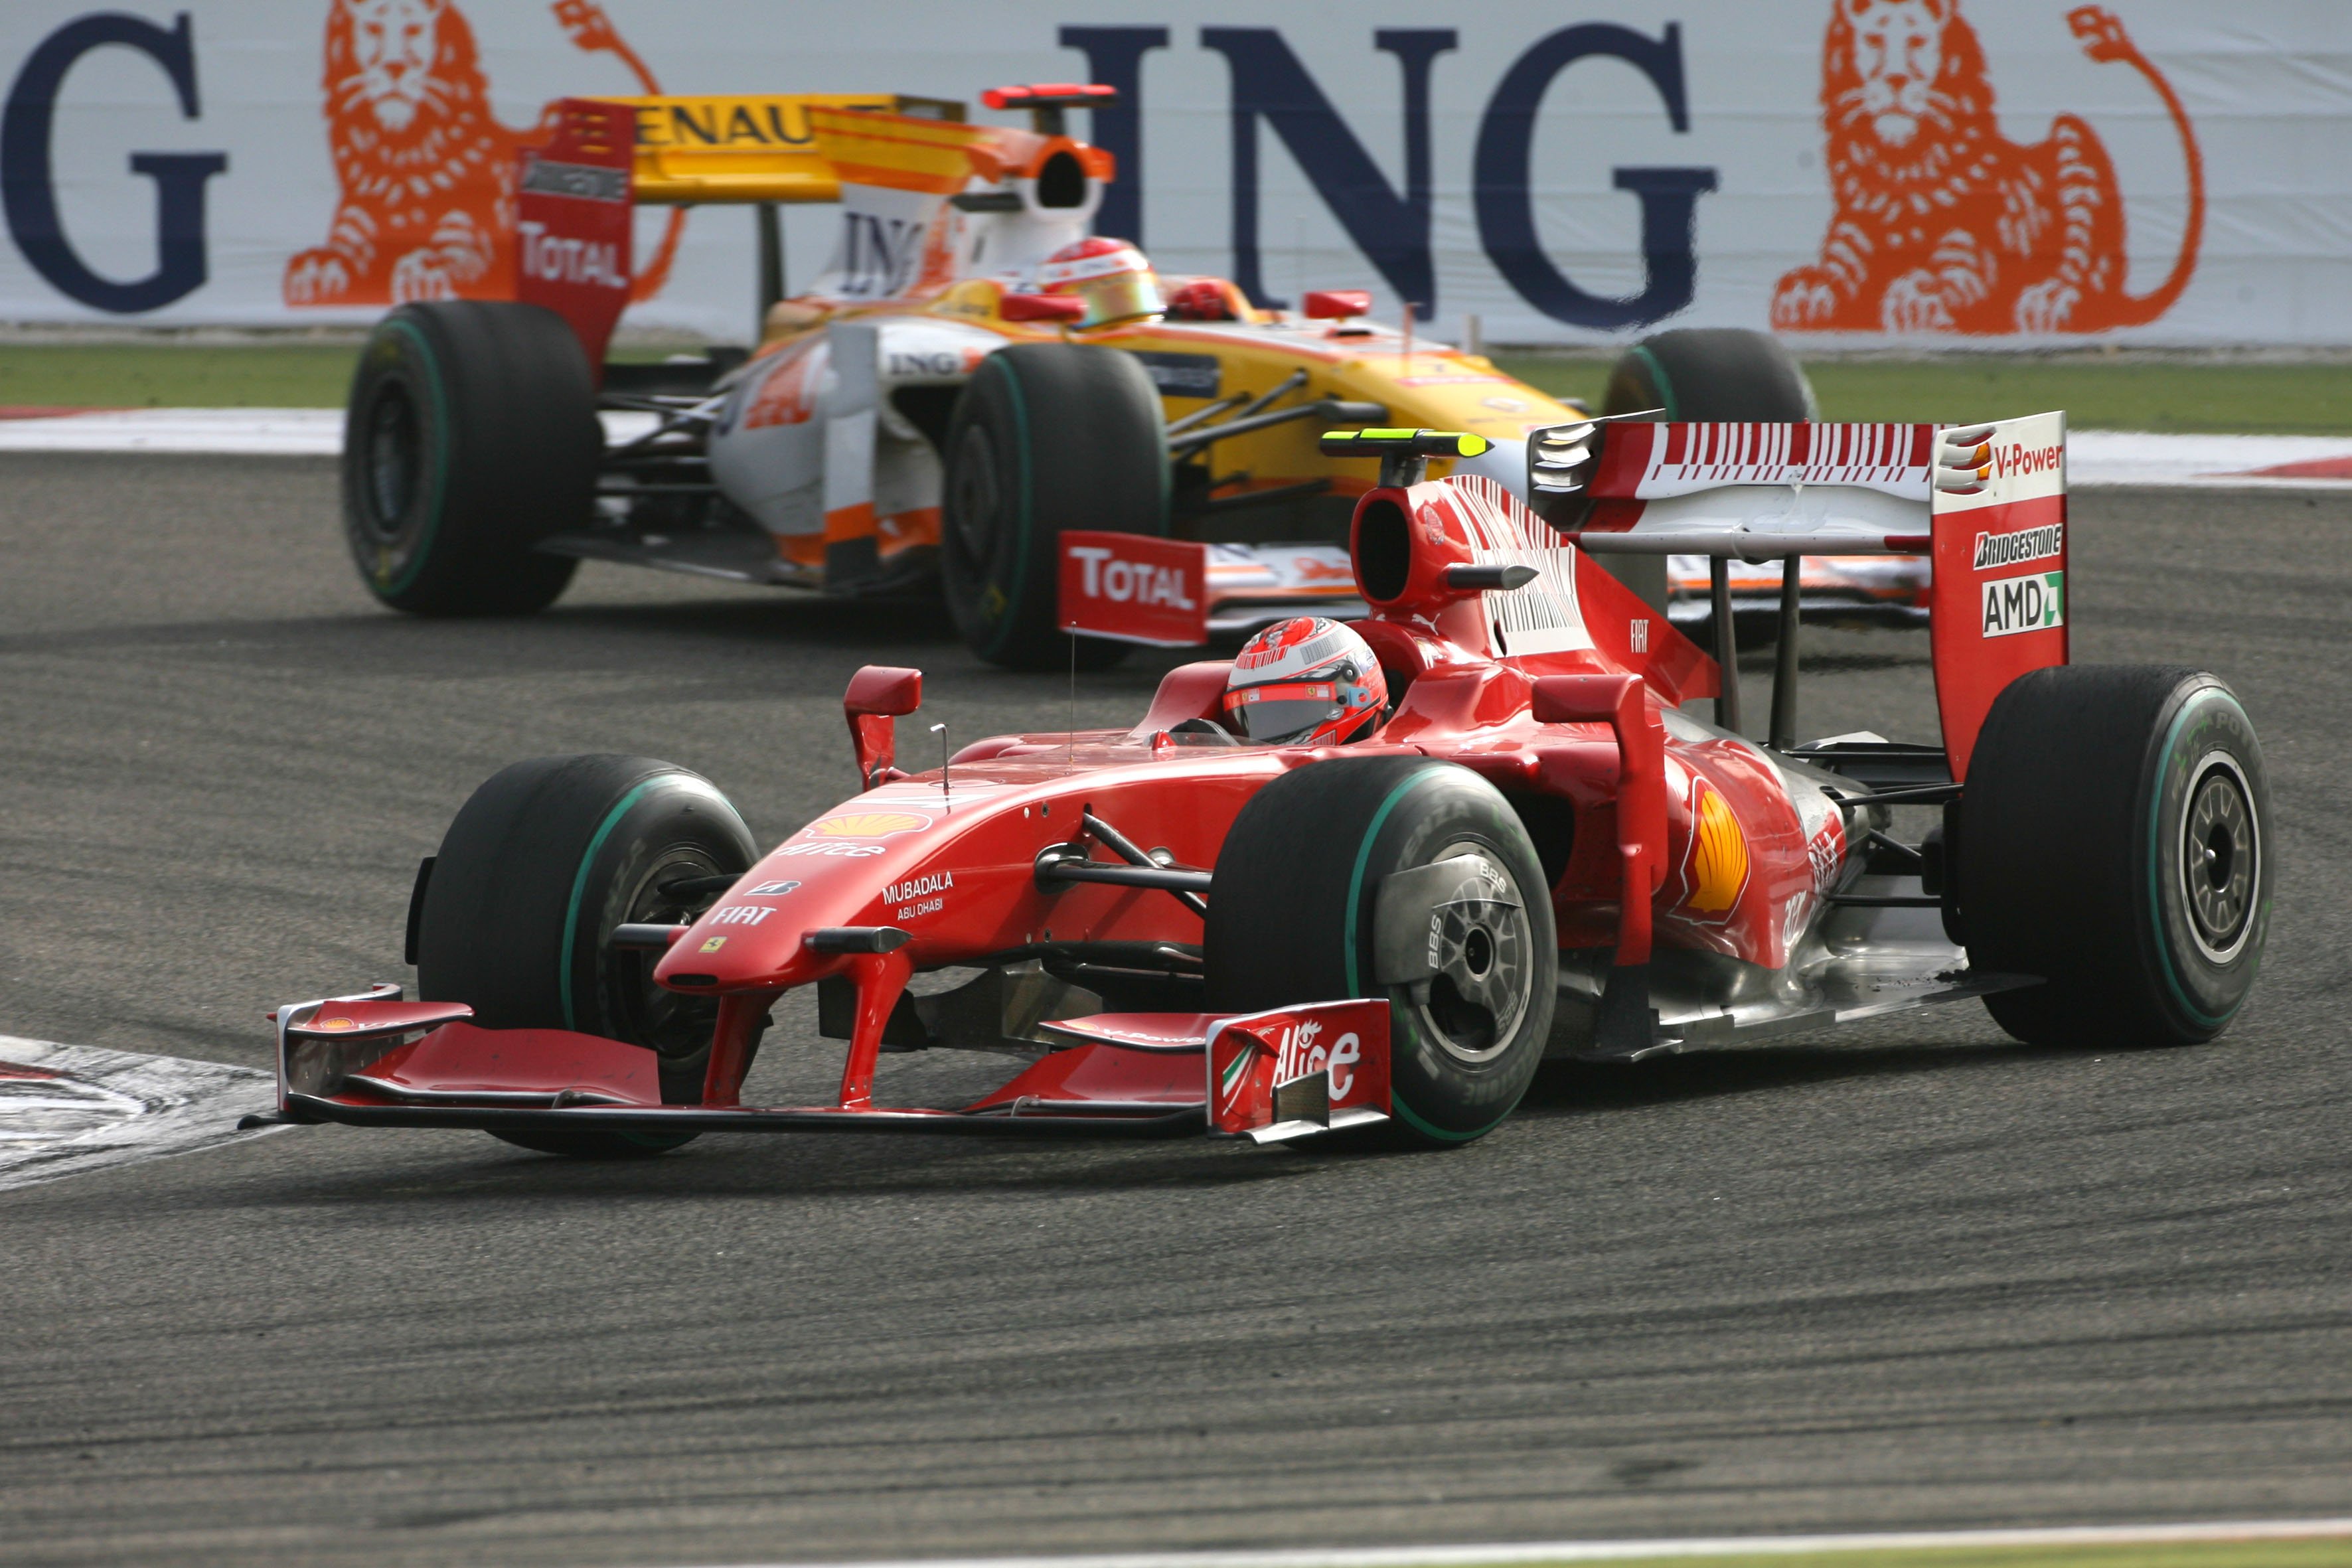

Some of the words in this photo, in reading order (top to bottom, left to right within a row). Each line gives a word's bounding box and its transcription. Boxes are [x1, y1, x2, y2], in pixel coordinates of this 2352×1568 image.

[1058, 20, 1720, 331] ING
[889, 351, 957, 375] ING
[1994, 443, 2063, 479] V-Power
[1974, 524, 2063, 570] BRIDGESTONE
[1068, 546, 1196, 610] TOTAL
[1984, 580, 2042, 633] AMD
[1630, 619, 1649, 653] FIAT
[882, 870, 953, 905] MUBADALA
[1480, 862, 1507, 894] BBS
[709, 905, 777, 926] FIAT
[897, 905, 916, 921] ABU
[917, 898, 943, 915] DHABI
[1428, 914, 1443, 969] BBS
